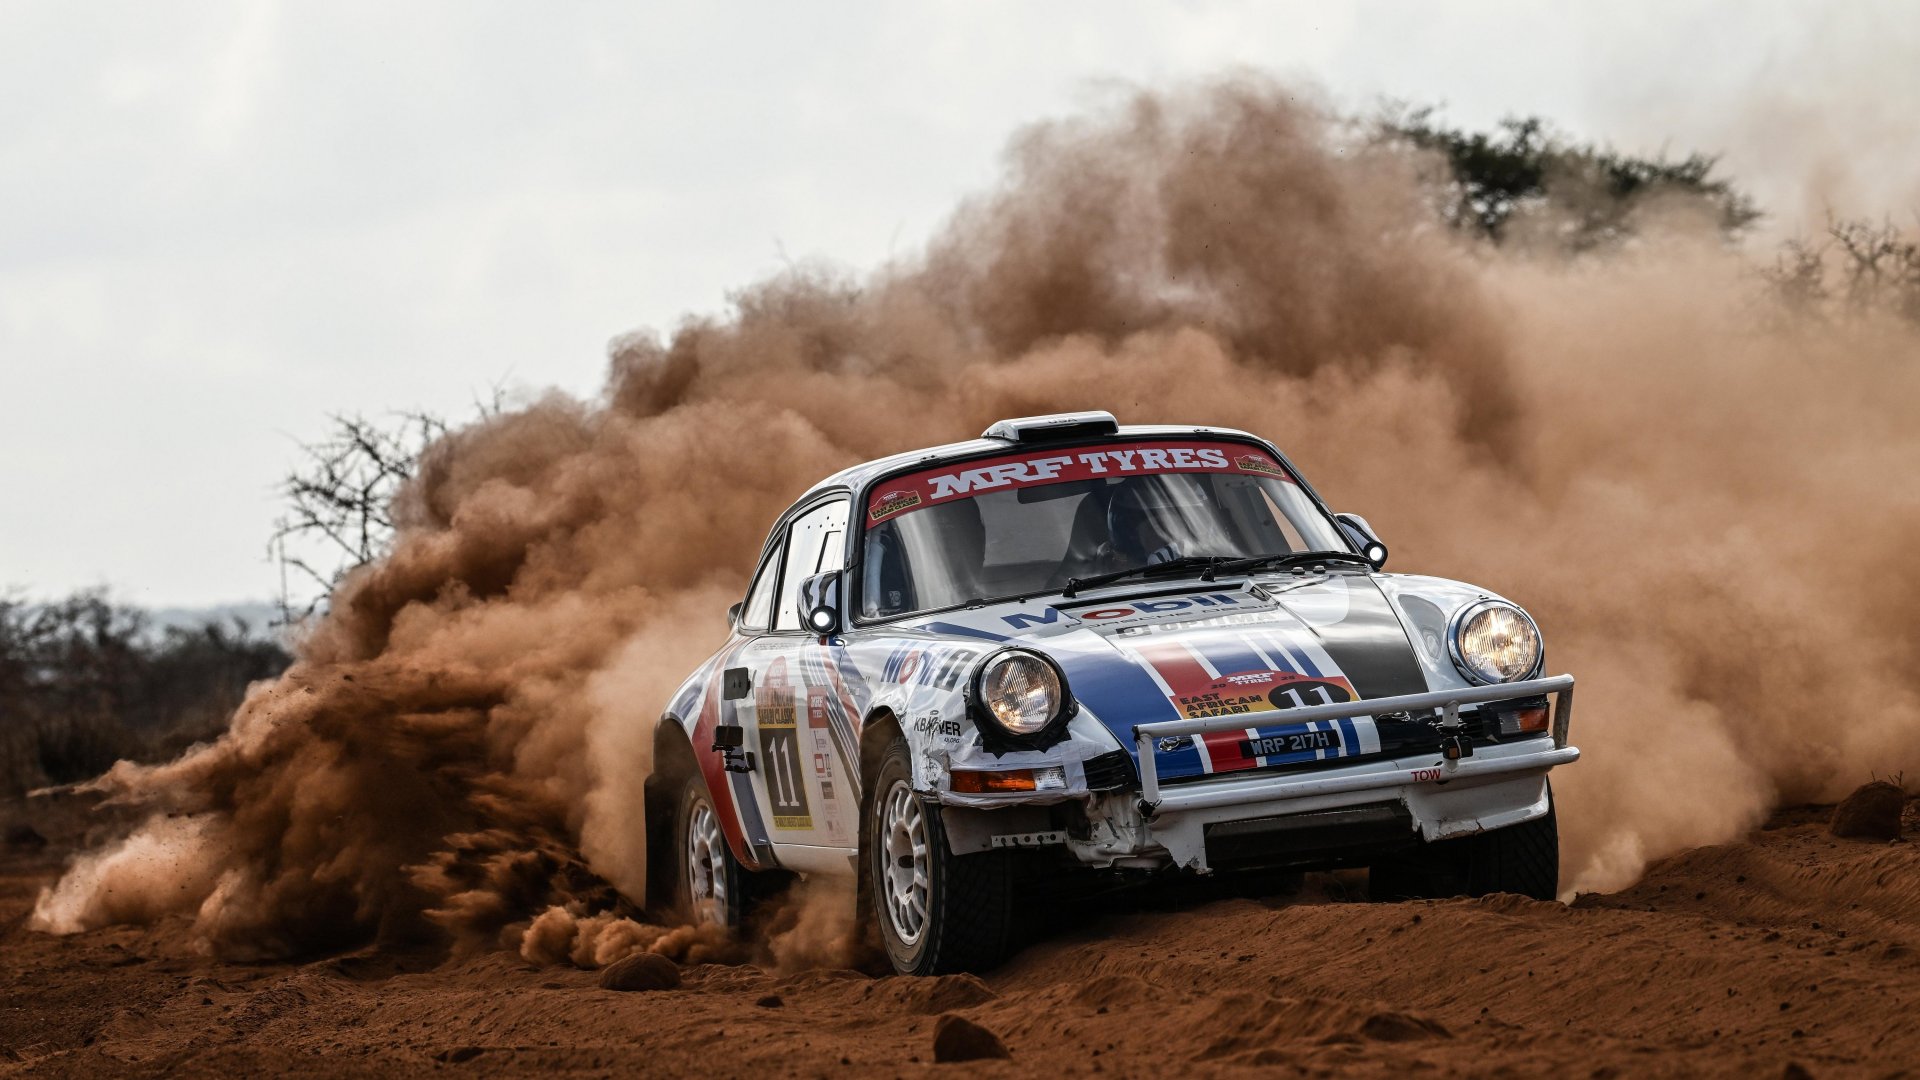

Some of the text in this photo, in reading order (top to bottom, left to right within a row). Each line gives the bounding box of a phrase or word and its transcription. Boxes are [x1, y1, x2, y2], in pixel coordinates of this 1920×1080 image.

[928, 449, 1229, 499] MRF TYRES
[1000, 594, 1239, 629] Mobil
[1227, 672, 1275, 683] MRF
[1179, 693, 1220, 705] EAST
[1187, 695, 1263, 713] AFRICAN
[1281, 686, 1334, 709] 11
[1189, 705, 1250, 718] SAFARI
[1250, 732, 1330, 755] WRP 217H
[769, 737, 800, 807] 11
[1411, 769, 1441, 781] TOW
